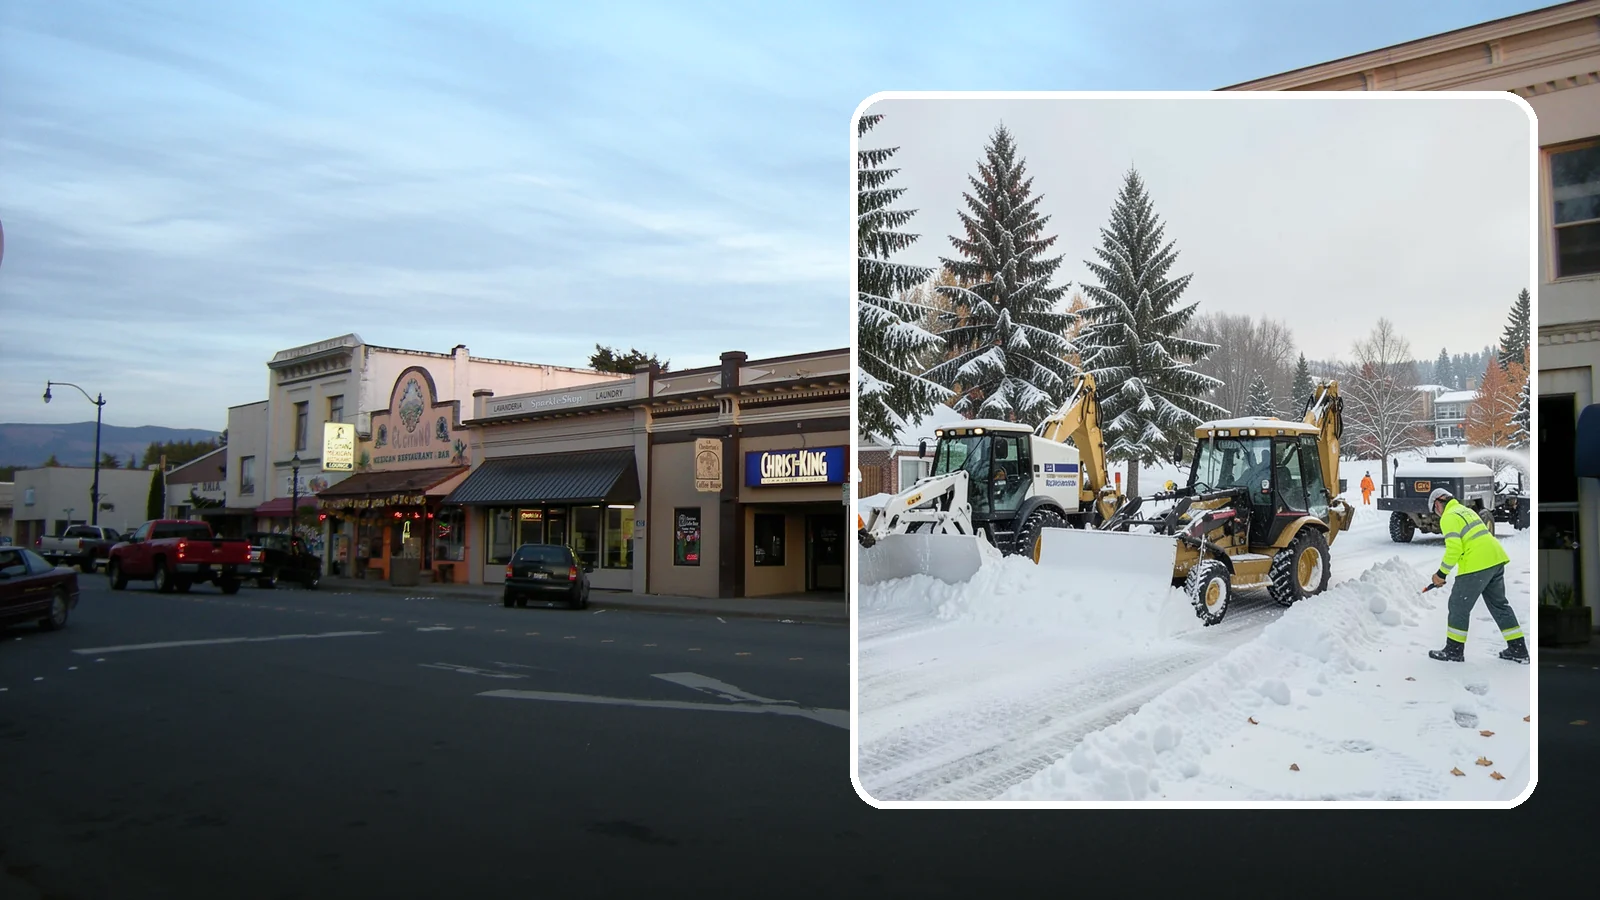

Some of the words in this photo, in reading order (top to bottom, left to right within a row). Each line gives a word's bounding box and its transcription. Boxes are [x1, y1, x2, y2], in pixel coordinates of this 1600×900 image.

[561, 394, 583, 407] Shop
[595, 389, 623, 400] LAUNDRY
[493, 402, 522, 413] LAVANDERIA
[373, 455, 396, 464] MEXICAN
[397, 451, 434, 462] RESTAURANT
[438, 450, 450, 459] BAR
[761, 452, 797, 478] CHRIST
[798, 450, 827, 476] KING
